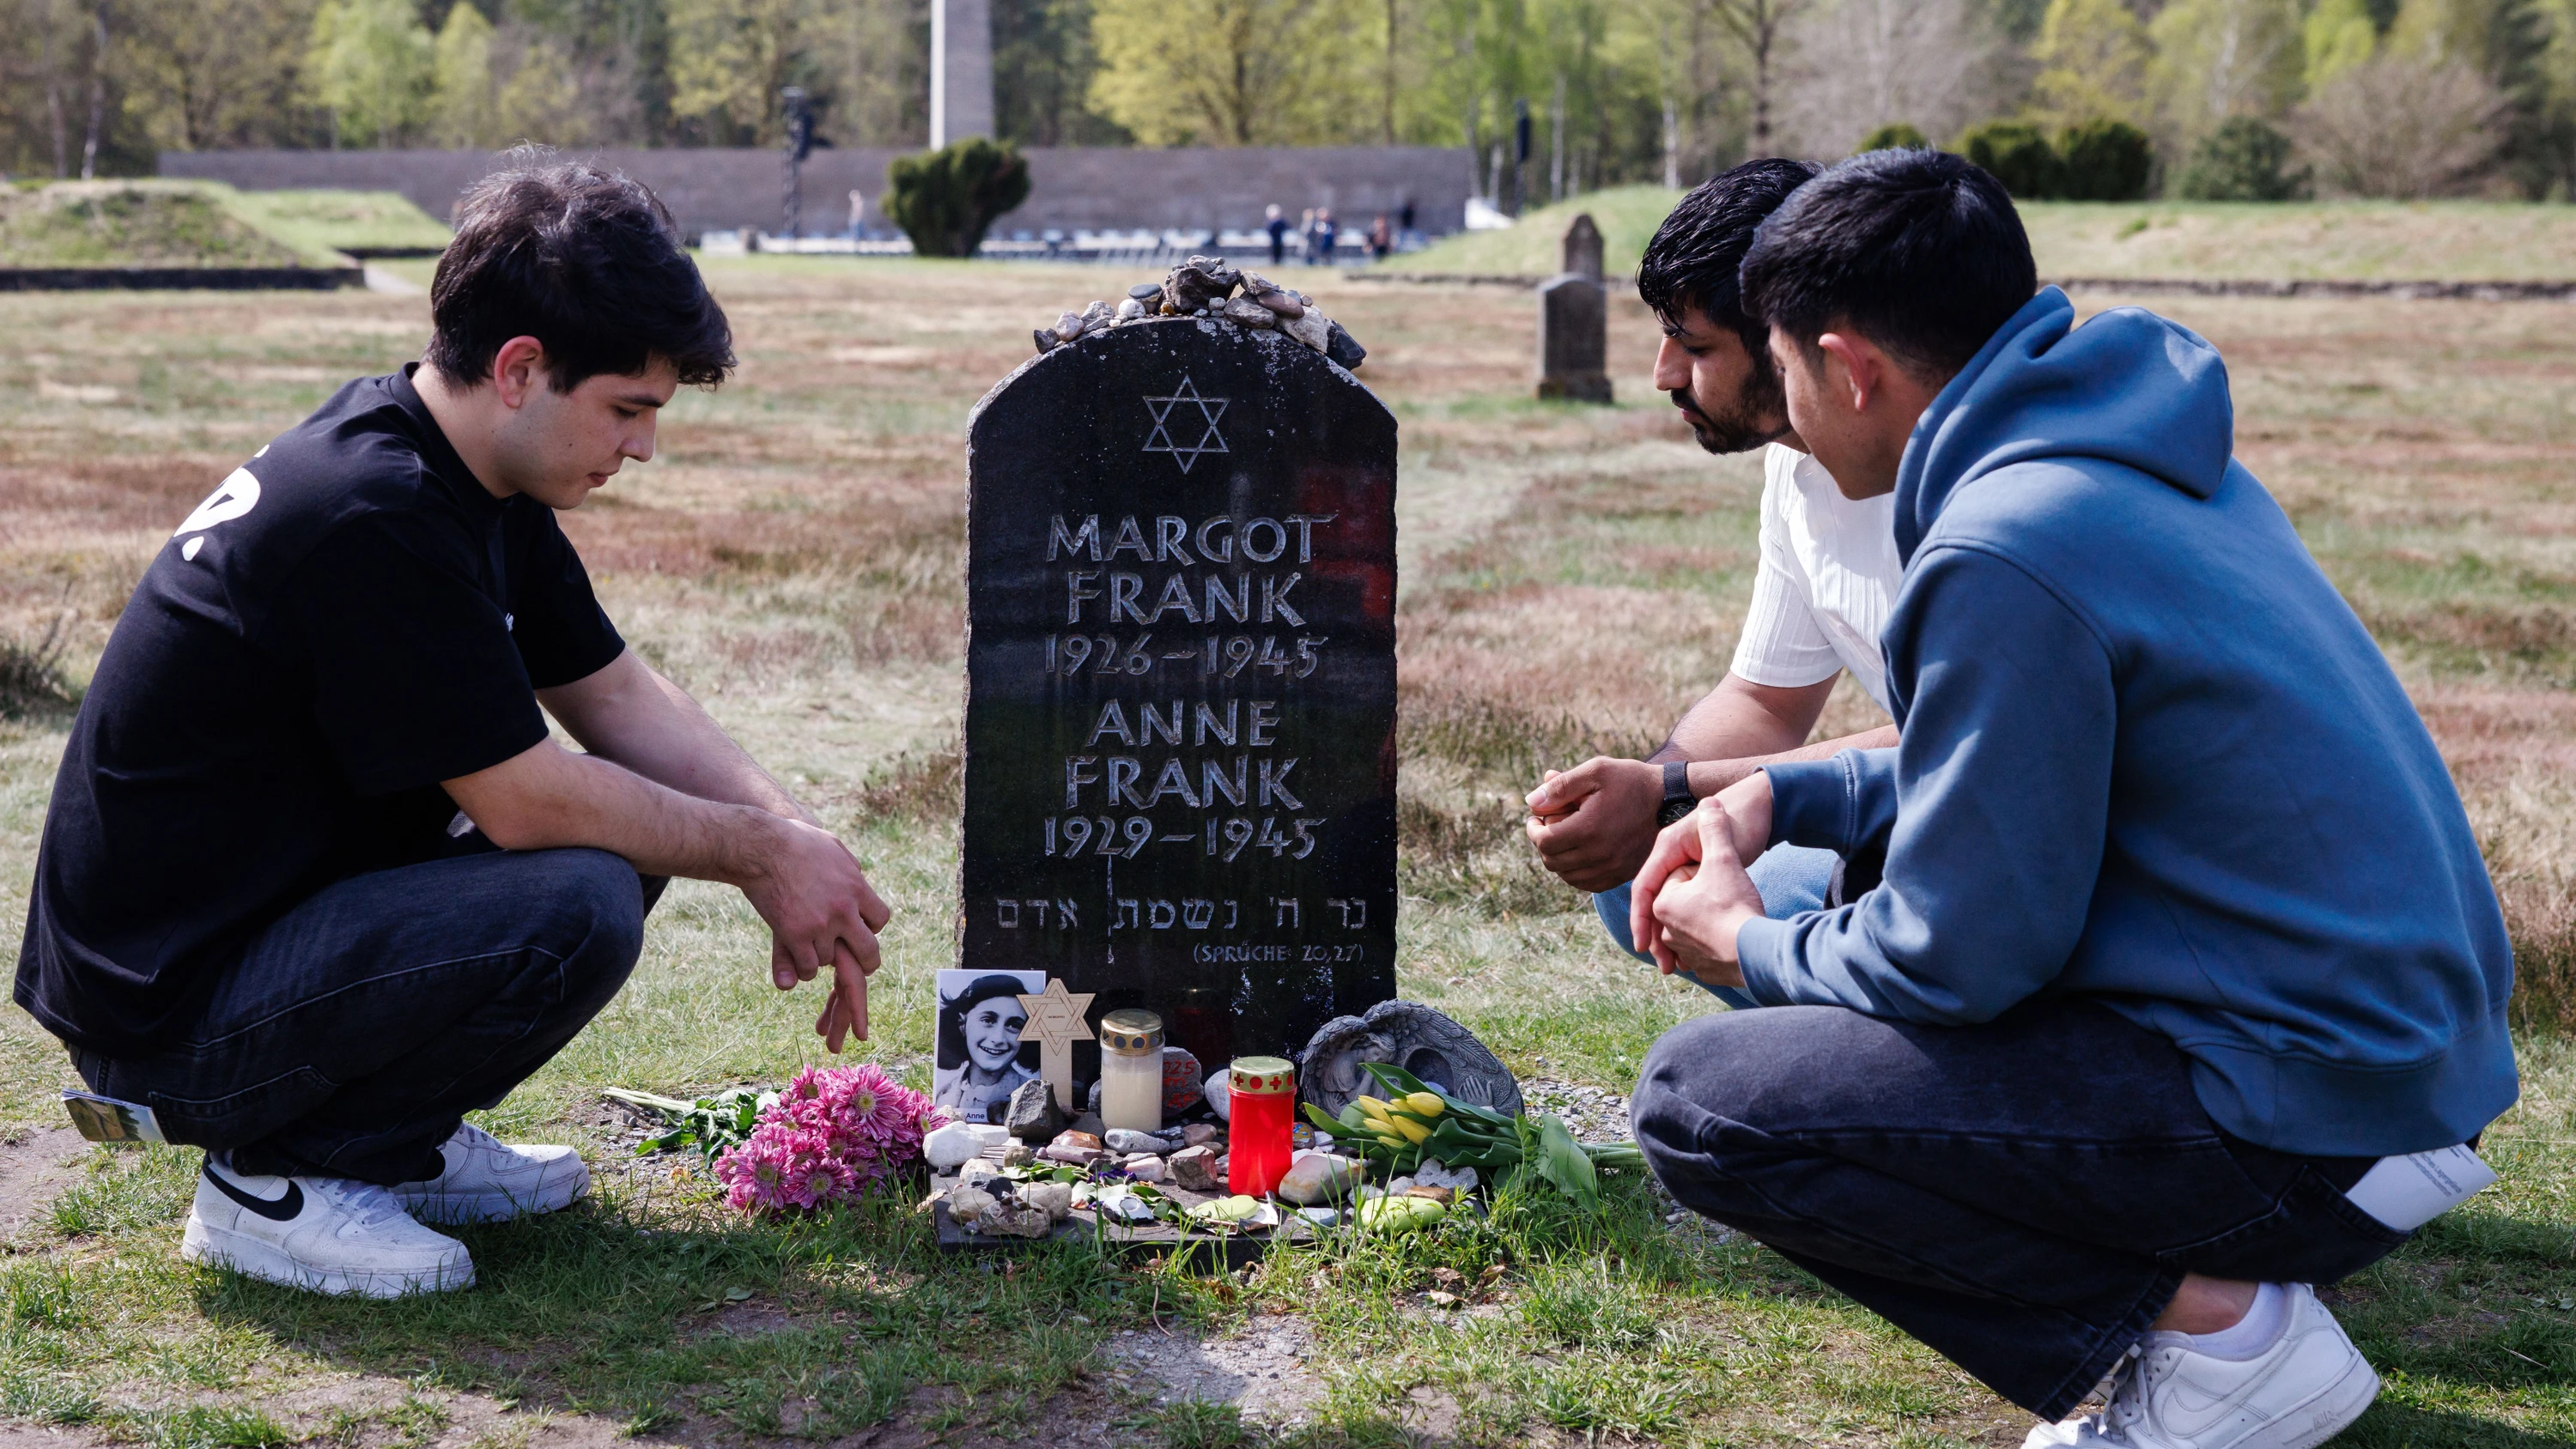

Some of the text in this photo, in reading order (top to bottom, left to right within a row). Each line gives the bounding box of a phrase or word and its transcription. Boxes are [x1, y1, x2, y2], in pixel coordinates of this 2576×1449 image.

[1046, 514, 1338, 566] MARGOT
[1067, 570, 1306, 627] FRANK
[1084, 698, 1279, 747] ANNE
[1065, 754, 1304, 810] FRANK
[995, 896, 1078, 931] אדם
[2312, 1410, 2338, 1432] AIR
